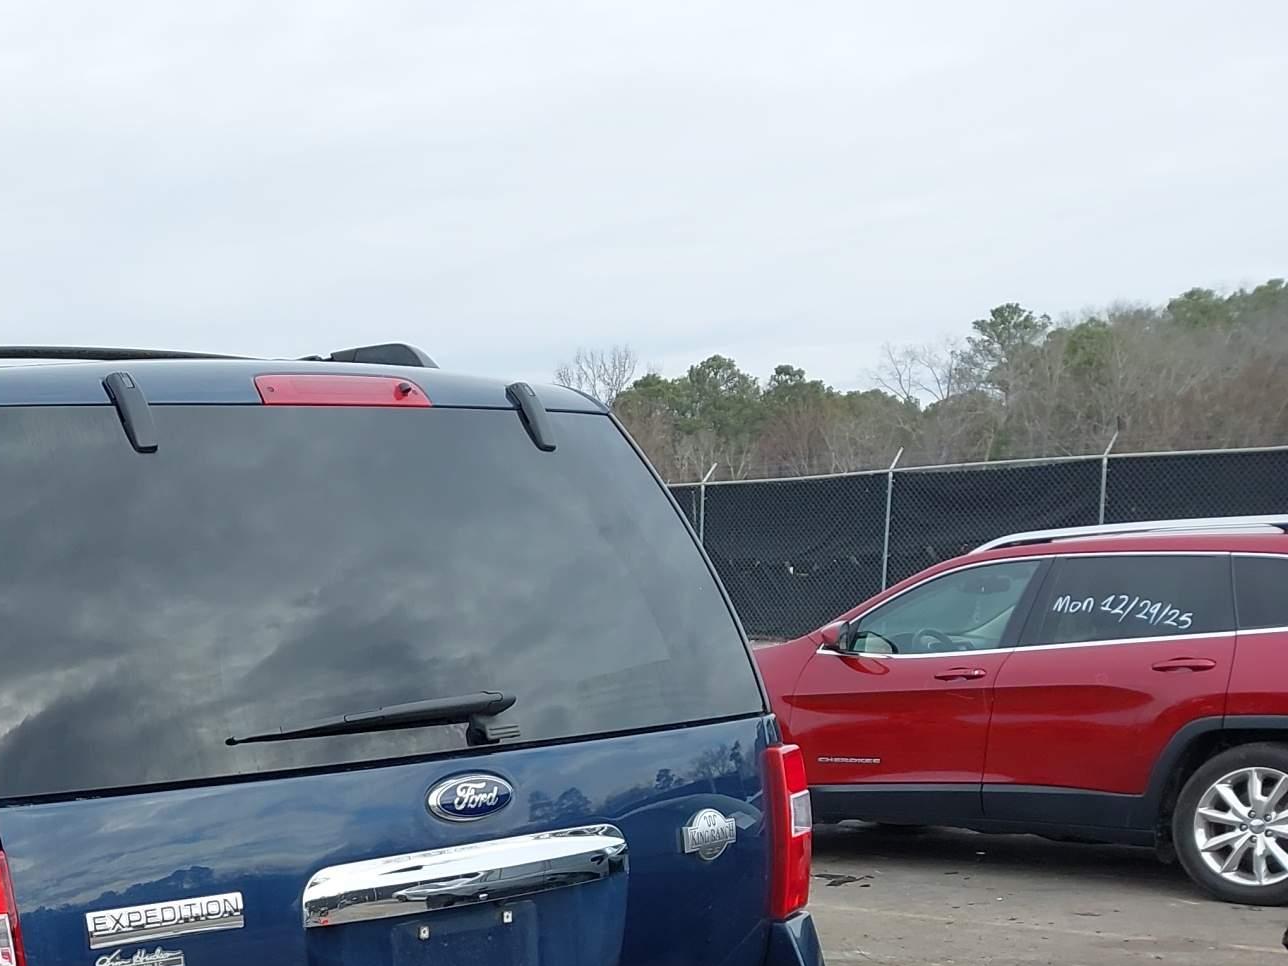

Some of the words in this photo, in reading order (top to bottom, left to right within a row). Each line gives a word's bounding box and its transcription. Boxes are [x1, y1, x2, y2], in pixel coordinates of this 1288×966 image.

[1052, 594, 1095, 613] Mon
[1100, 594, 1193, 629] 12/29/25
[454, 781, 499, 811] Ford
[92, 897, 240, 932] EXPEDITION
